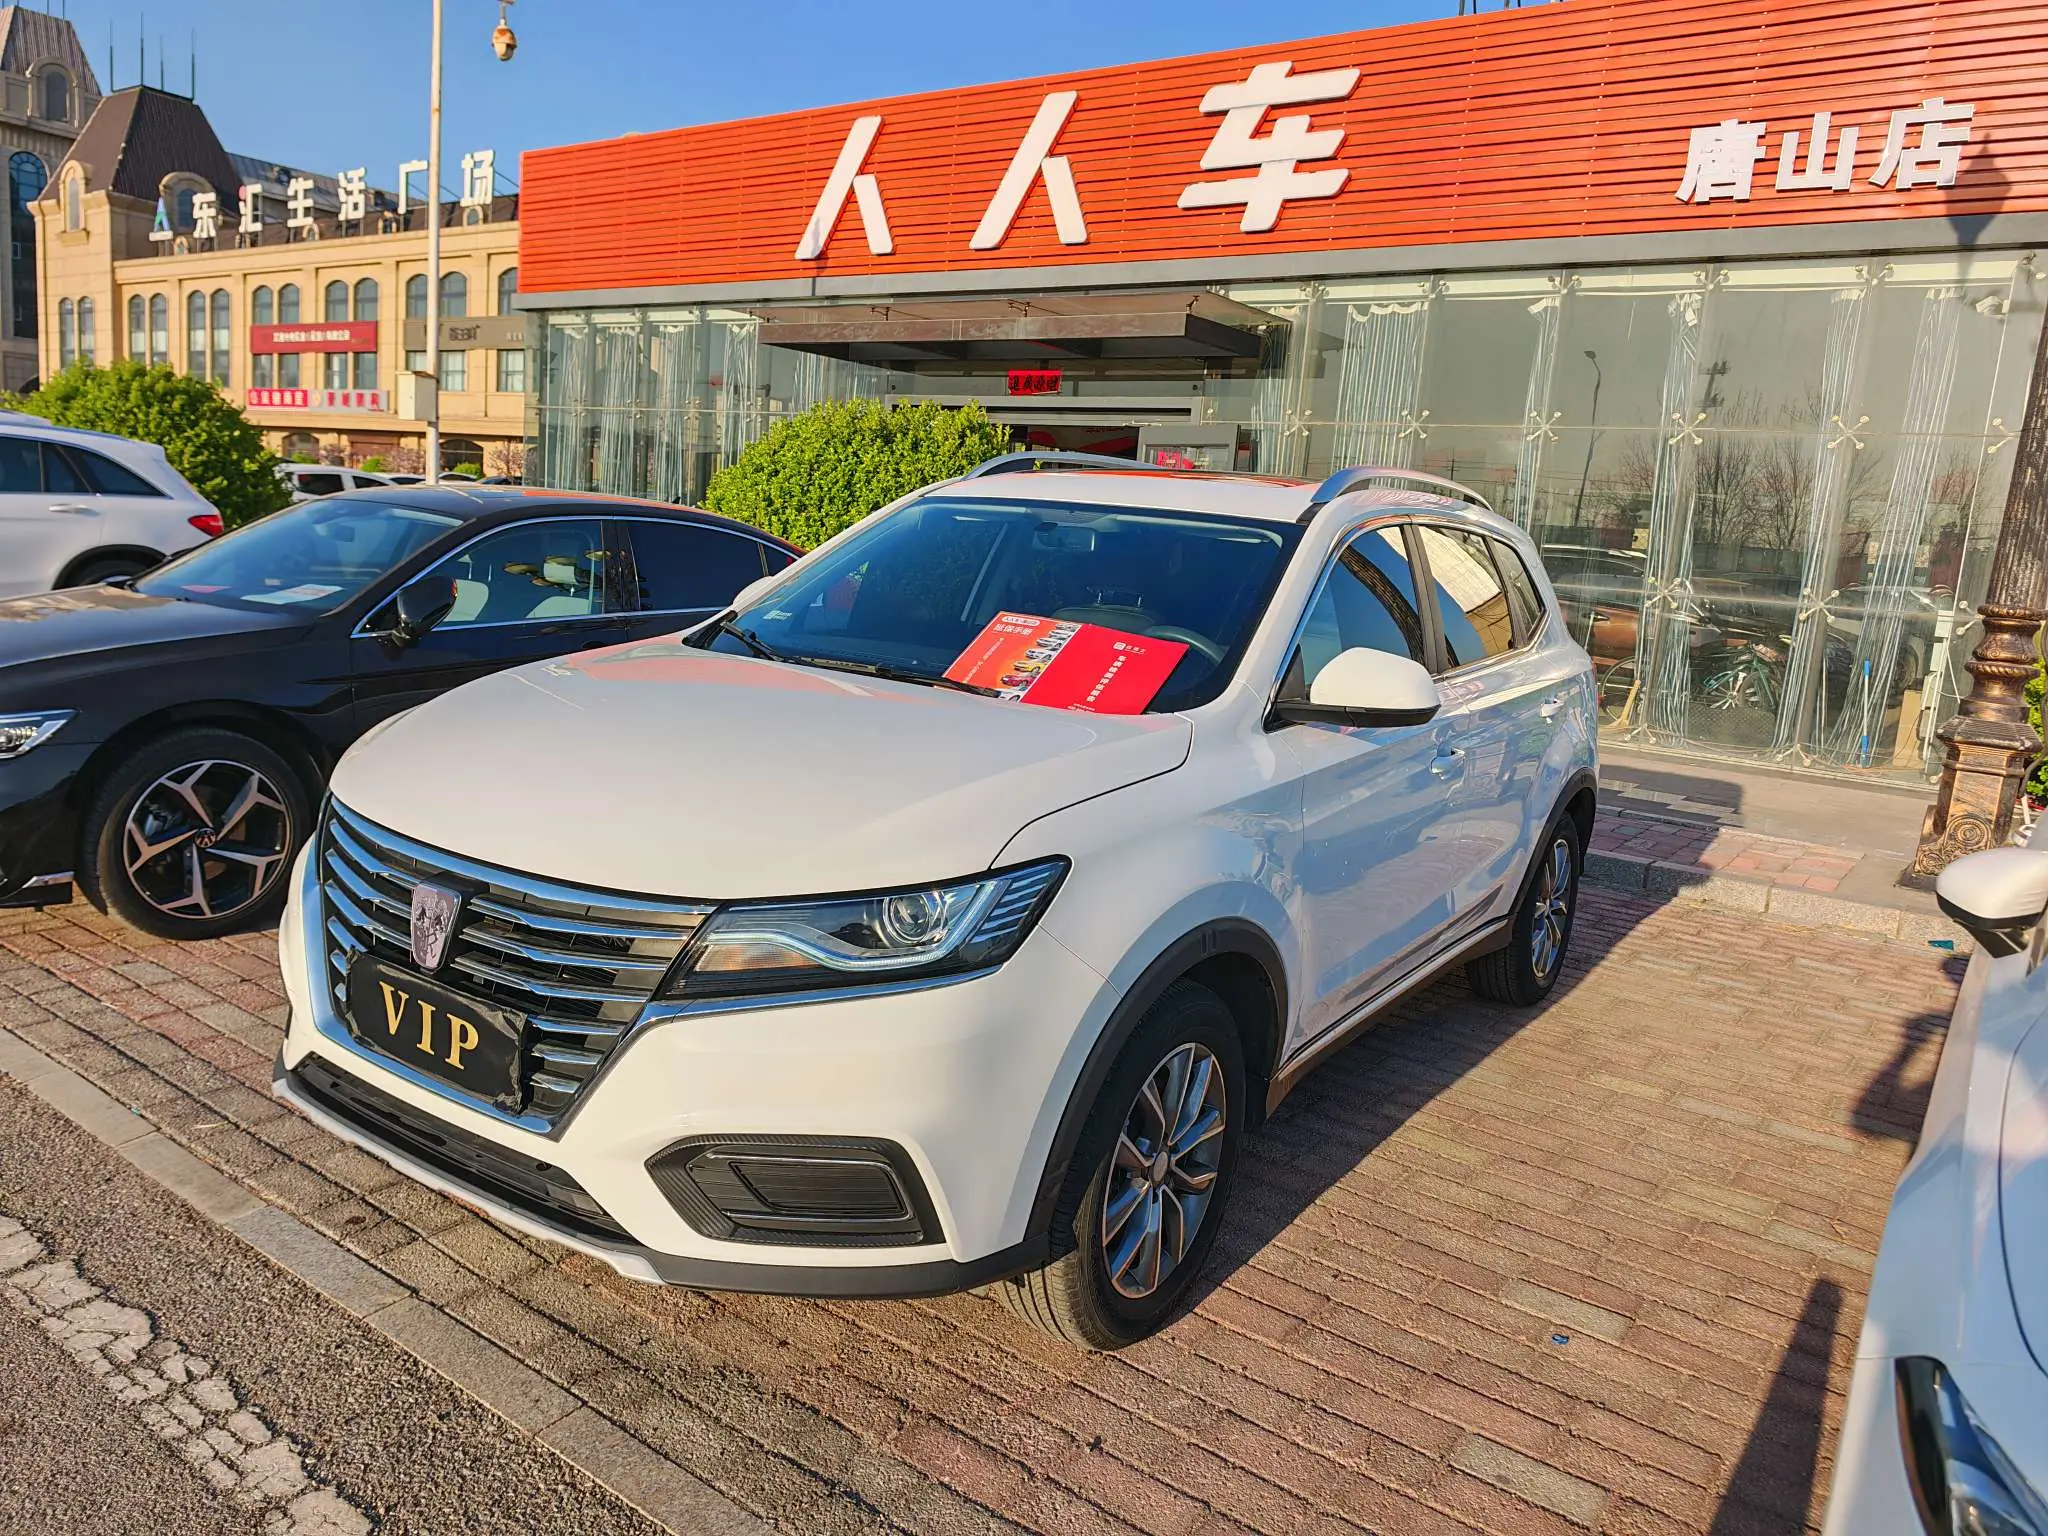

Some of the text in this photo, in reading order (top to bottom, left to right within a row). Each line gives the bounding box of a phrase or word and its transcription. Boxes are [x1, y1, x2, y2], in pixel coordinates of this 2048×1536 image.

[191, 149, 496, 240] 东汇生活广场
[794, 59, 1362, 261] 人人车
[1674, 96, 1977, 204] 唐山店
[379, 980, 479, 1070] VIP
